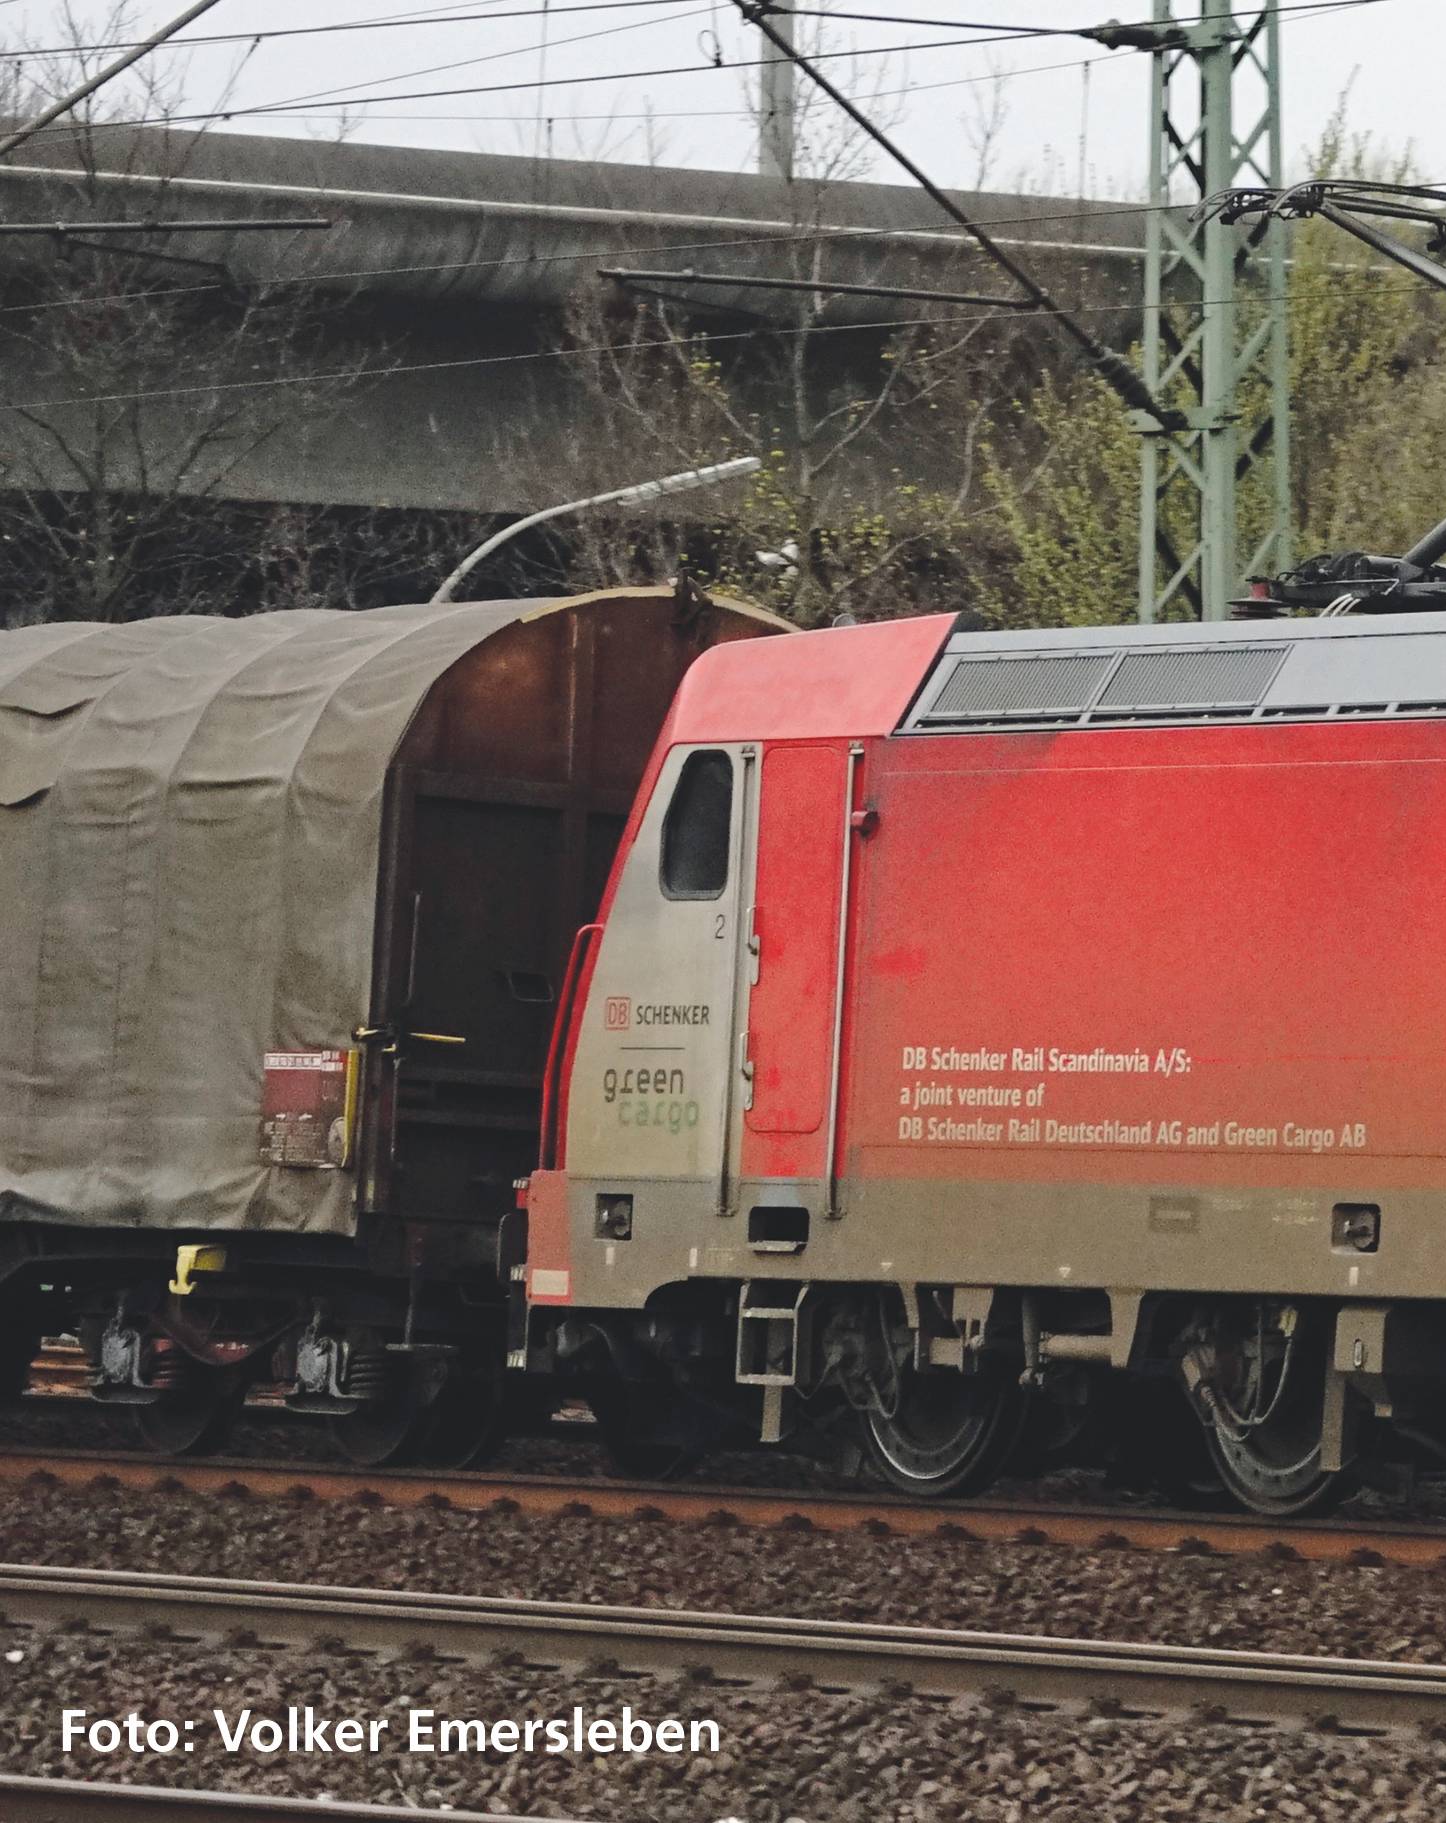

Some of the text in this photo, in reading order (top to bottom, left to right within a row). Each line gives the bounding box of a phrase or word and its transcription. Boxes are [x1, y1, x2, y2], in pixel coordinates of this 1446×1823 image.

[714, 914, 726, 939] 2
[607, 1002, 710, 1025] DB SCHENKER
[902, 1047, 1191, 1077] DB Schenker Rail Scandinavia A/S:
[604, 1067, 684, 1103] green
[900, 1082, 1045, 1110] a joint venture of
[618, 1100, 699, 1135] cargo
[899, 1116, 1366, 1152] DB Schenker Rail Deutschland AG and Green Cargo AB
